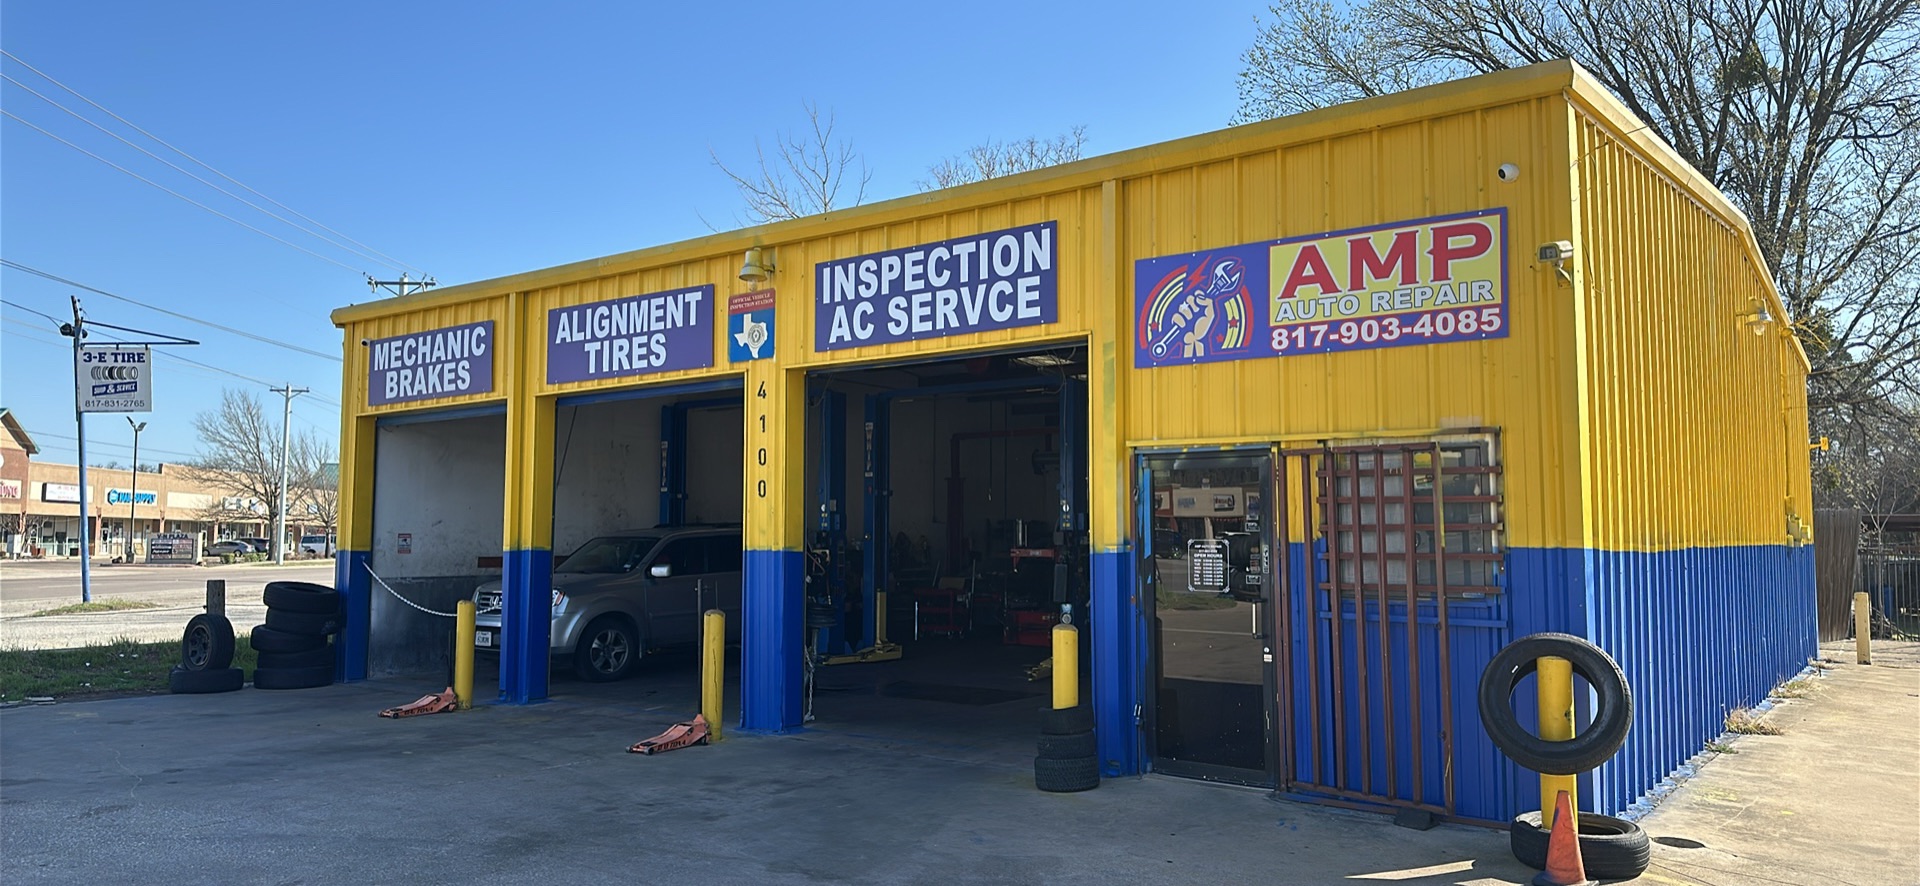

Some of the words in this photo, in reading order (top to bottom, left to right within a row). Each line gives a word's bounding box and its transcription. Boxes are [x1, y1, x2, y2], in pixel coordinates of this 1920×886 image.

[823, 228, 1050, 304] INSPECTION
[1277, 221, 1493, 300] AMP
[555, 291, 702, 344] ALIGNMENT
[730, 302, 754, 310] INSPECTION
[829, 301, 875, 344] AC
[887, 275, 1041, 335] SERVCE
[1275, 295, 1360, 322] AUTO
[1371, 280, 1495, 312] REPAIR
[374, 326, 486, 371] MECHANIC
[1271, 307, 1501, 350] 817-903-4085
[83, 352, 107, 363] 3-E
[111, 352, 145, 363] TIRE
[584, 333, 667, 374] TIRES
[107, 384, 115, 393] &
[386, 360, 471, 399] BRAKES
[85, 399, 145, 408] 817-831-2765
